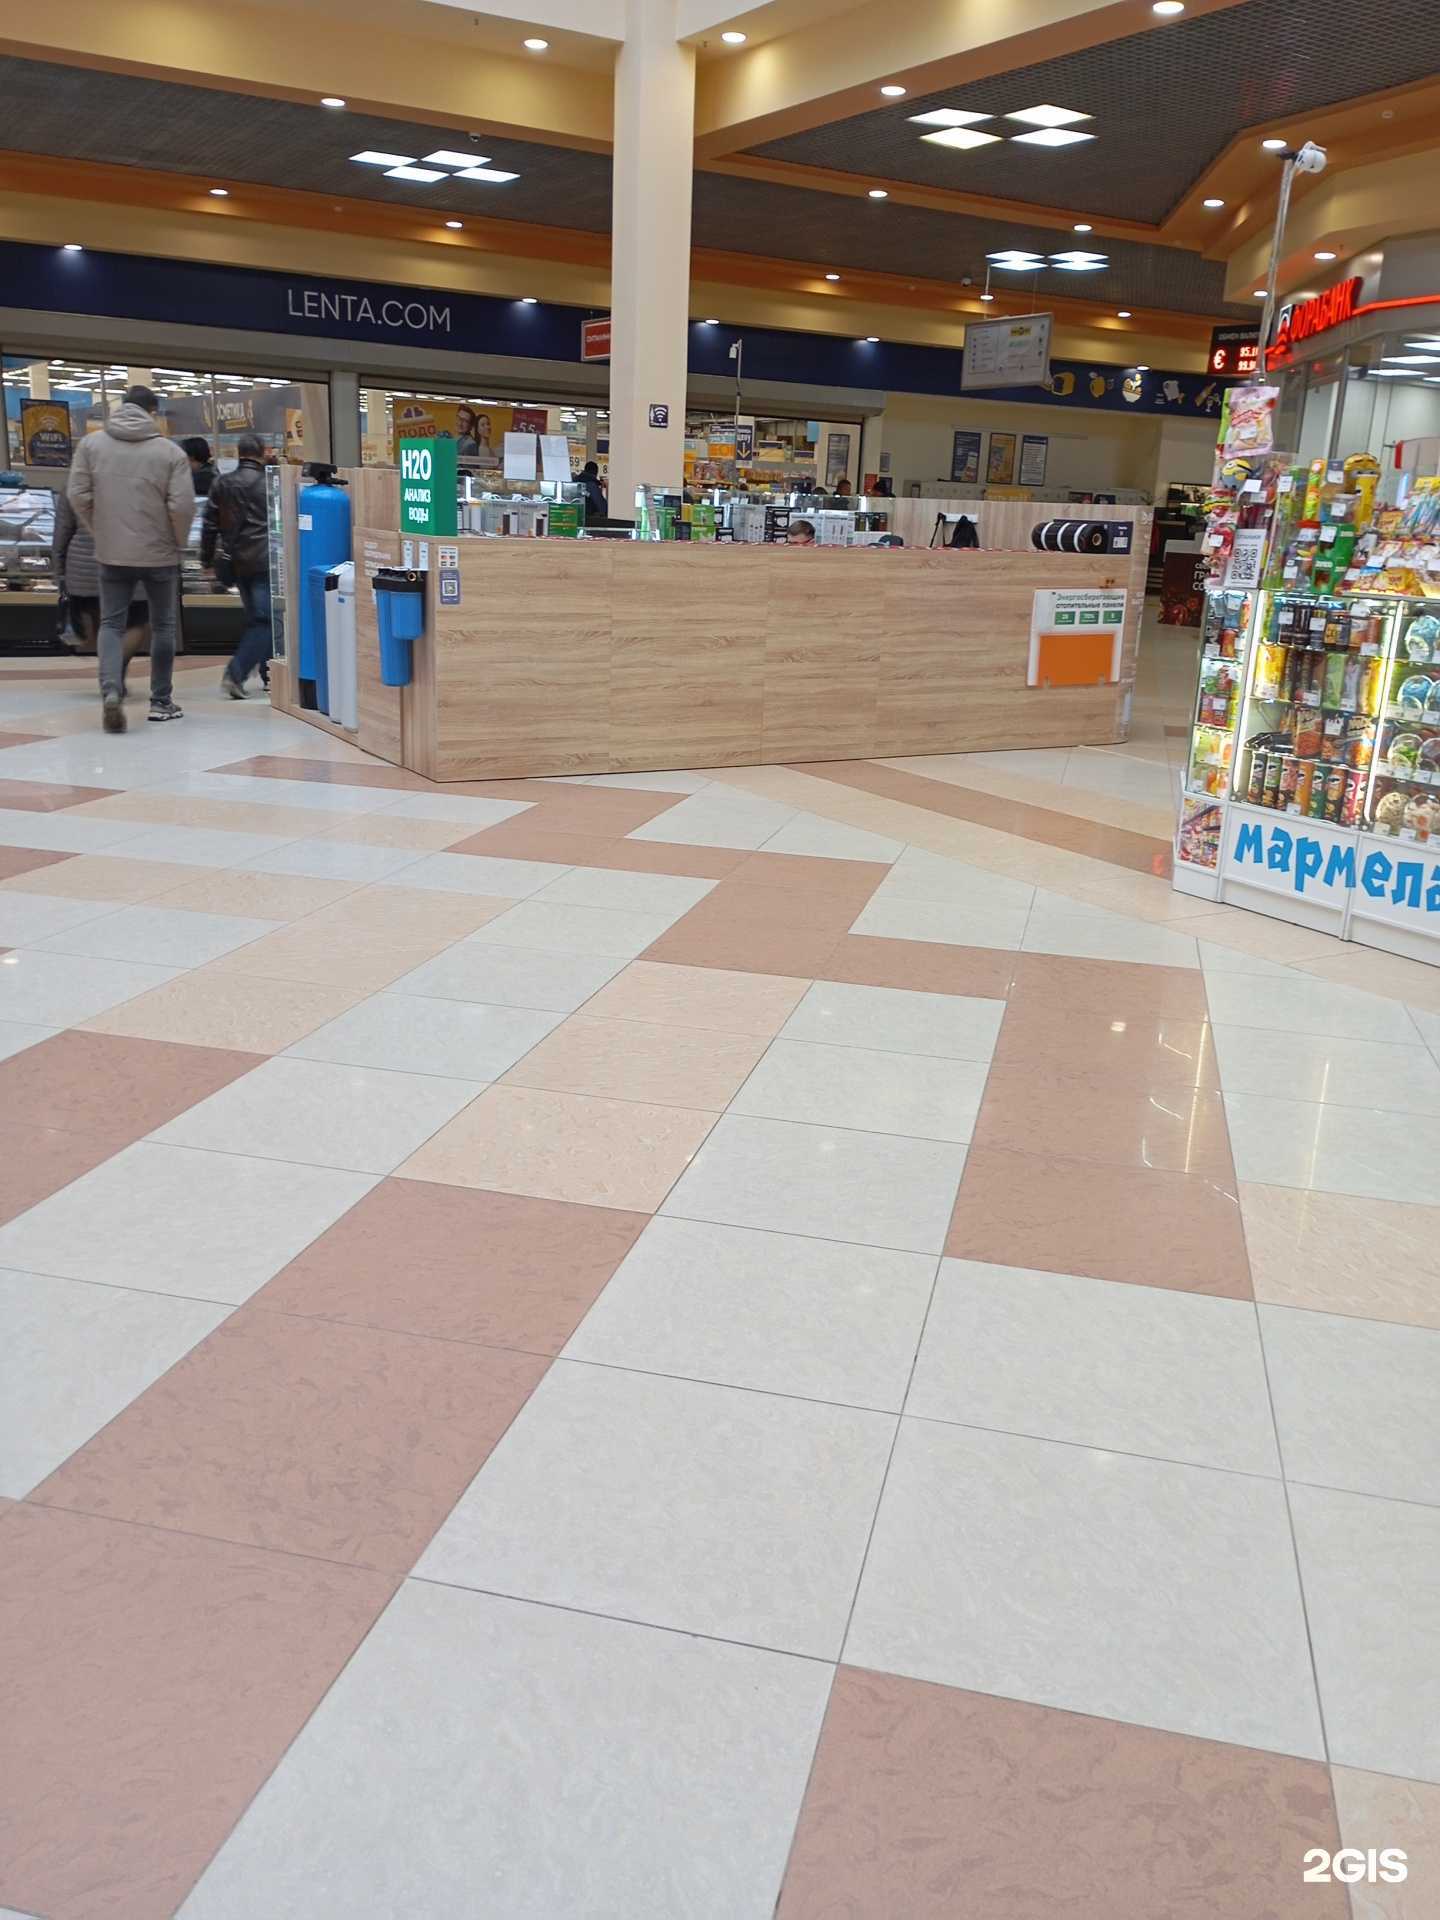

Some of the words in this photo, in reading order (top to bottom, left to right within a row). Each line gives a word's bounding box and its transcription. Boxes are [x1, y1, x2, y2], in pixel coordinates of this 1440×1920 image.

[288, 289, 451, 332] LENTA.COM
[1291, 277, 1359, 342] ФОРАБАНК
[402, 449, 432, 481] H2O
[404, 487, 432, 503] АНАЛИЗ
[408, 506, 429, 523] ВОДЫ
